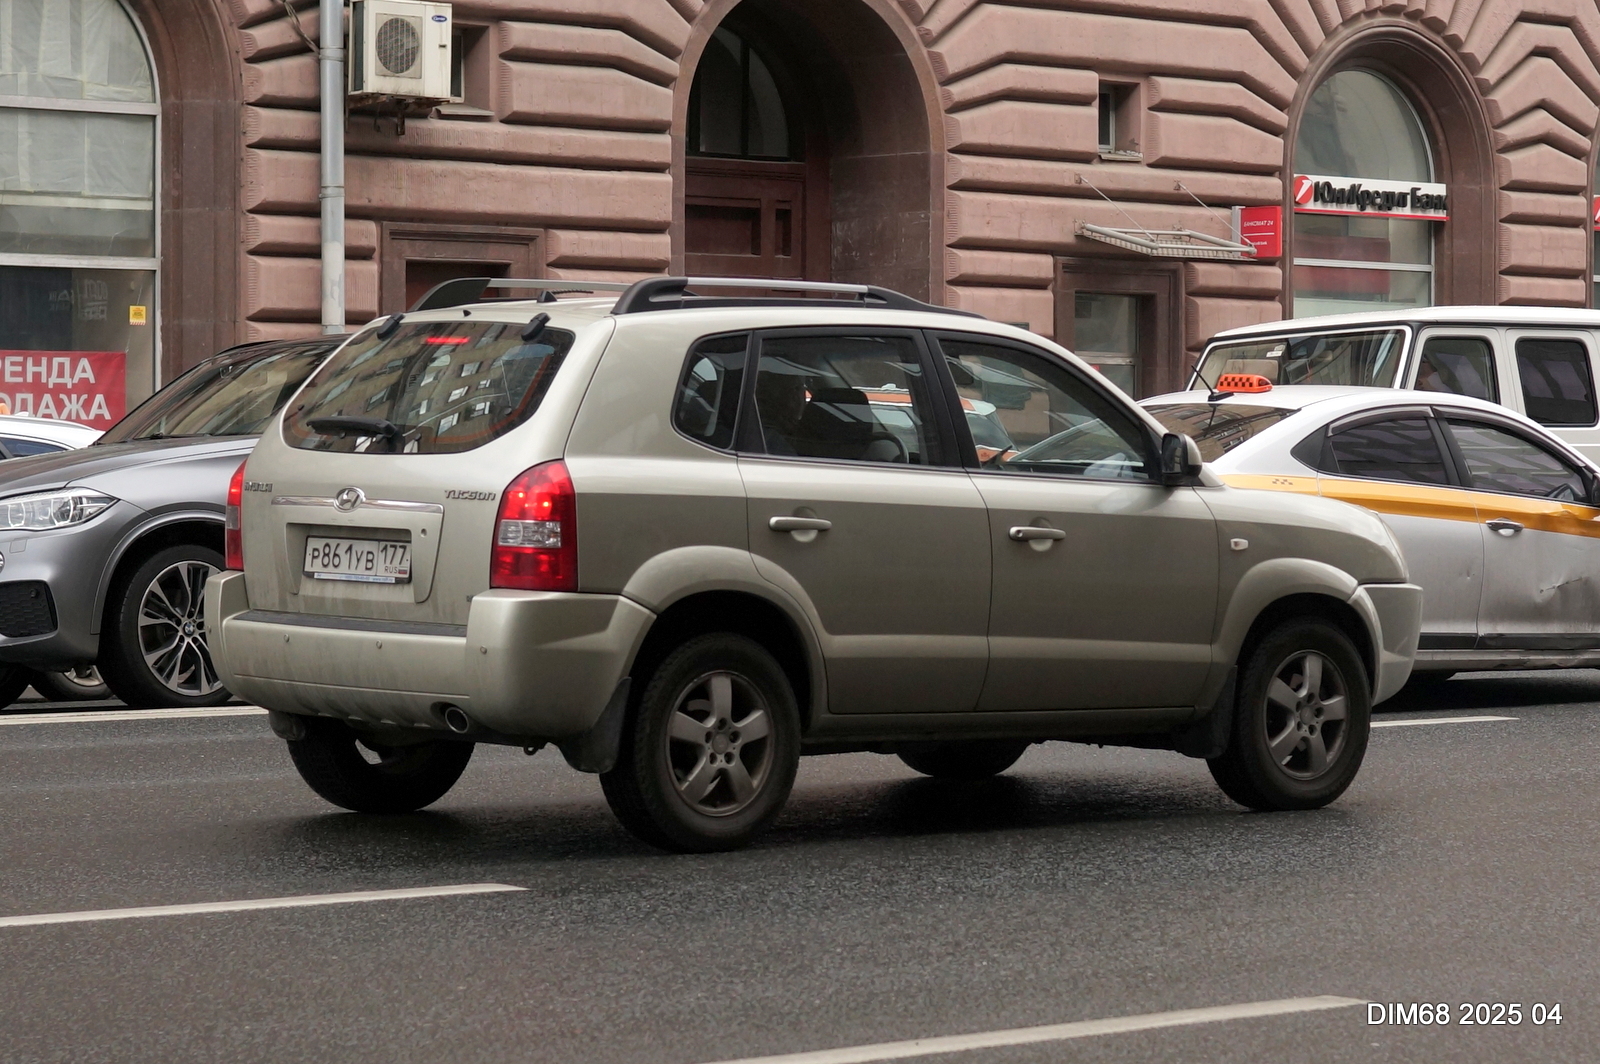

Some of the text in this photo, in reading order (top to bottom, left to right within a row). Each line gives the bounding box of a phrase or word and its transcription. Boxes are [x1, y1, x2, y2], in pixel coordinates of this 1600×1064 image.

[1314, 180, 1448, 211] ЮниКредит Банк
[0, 356, 96, 388] ЕНДА
[444, 489, 497, 501] TUCSON
[310, 542, 407, 571] Р861УВ 177
[384, 565, 398, 574] RUS
